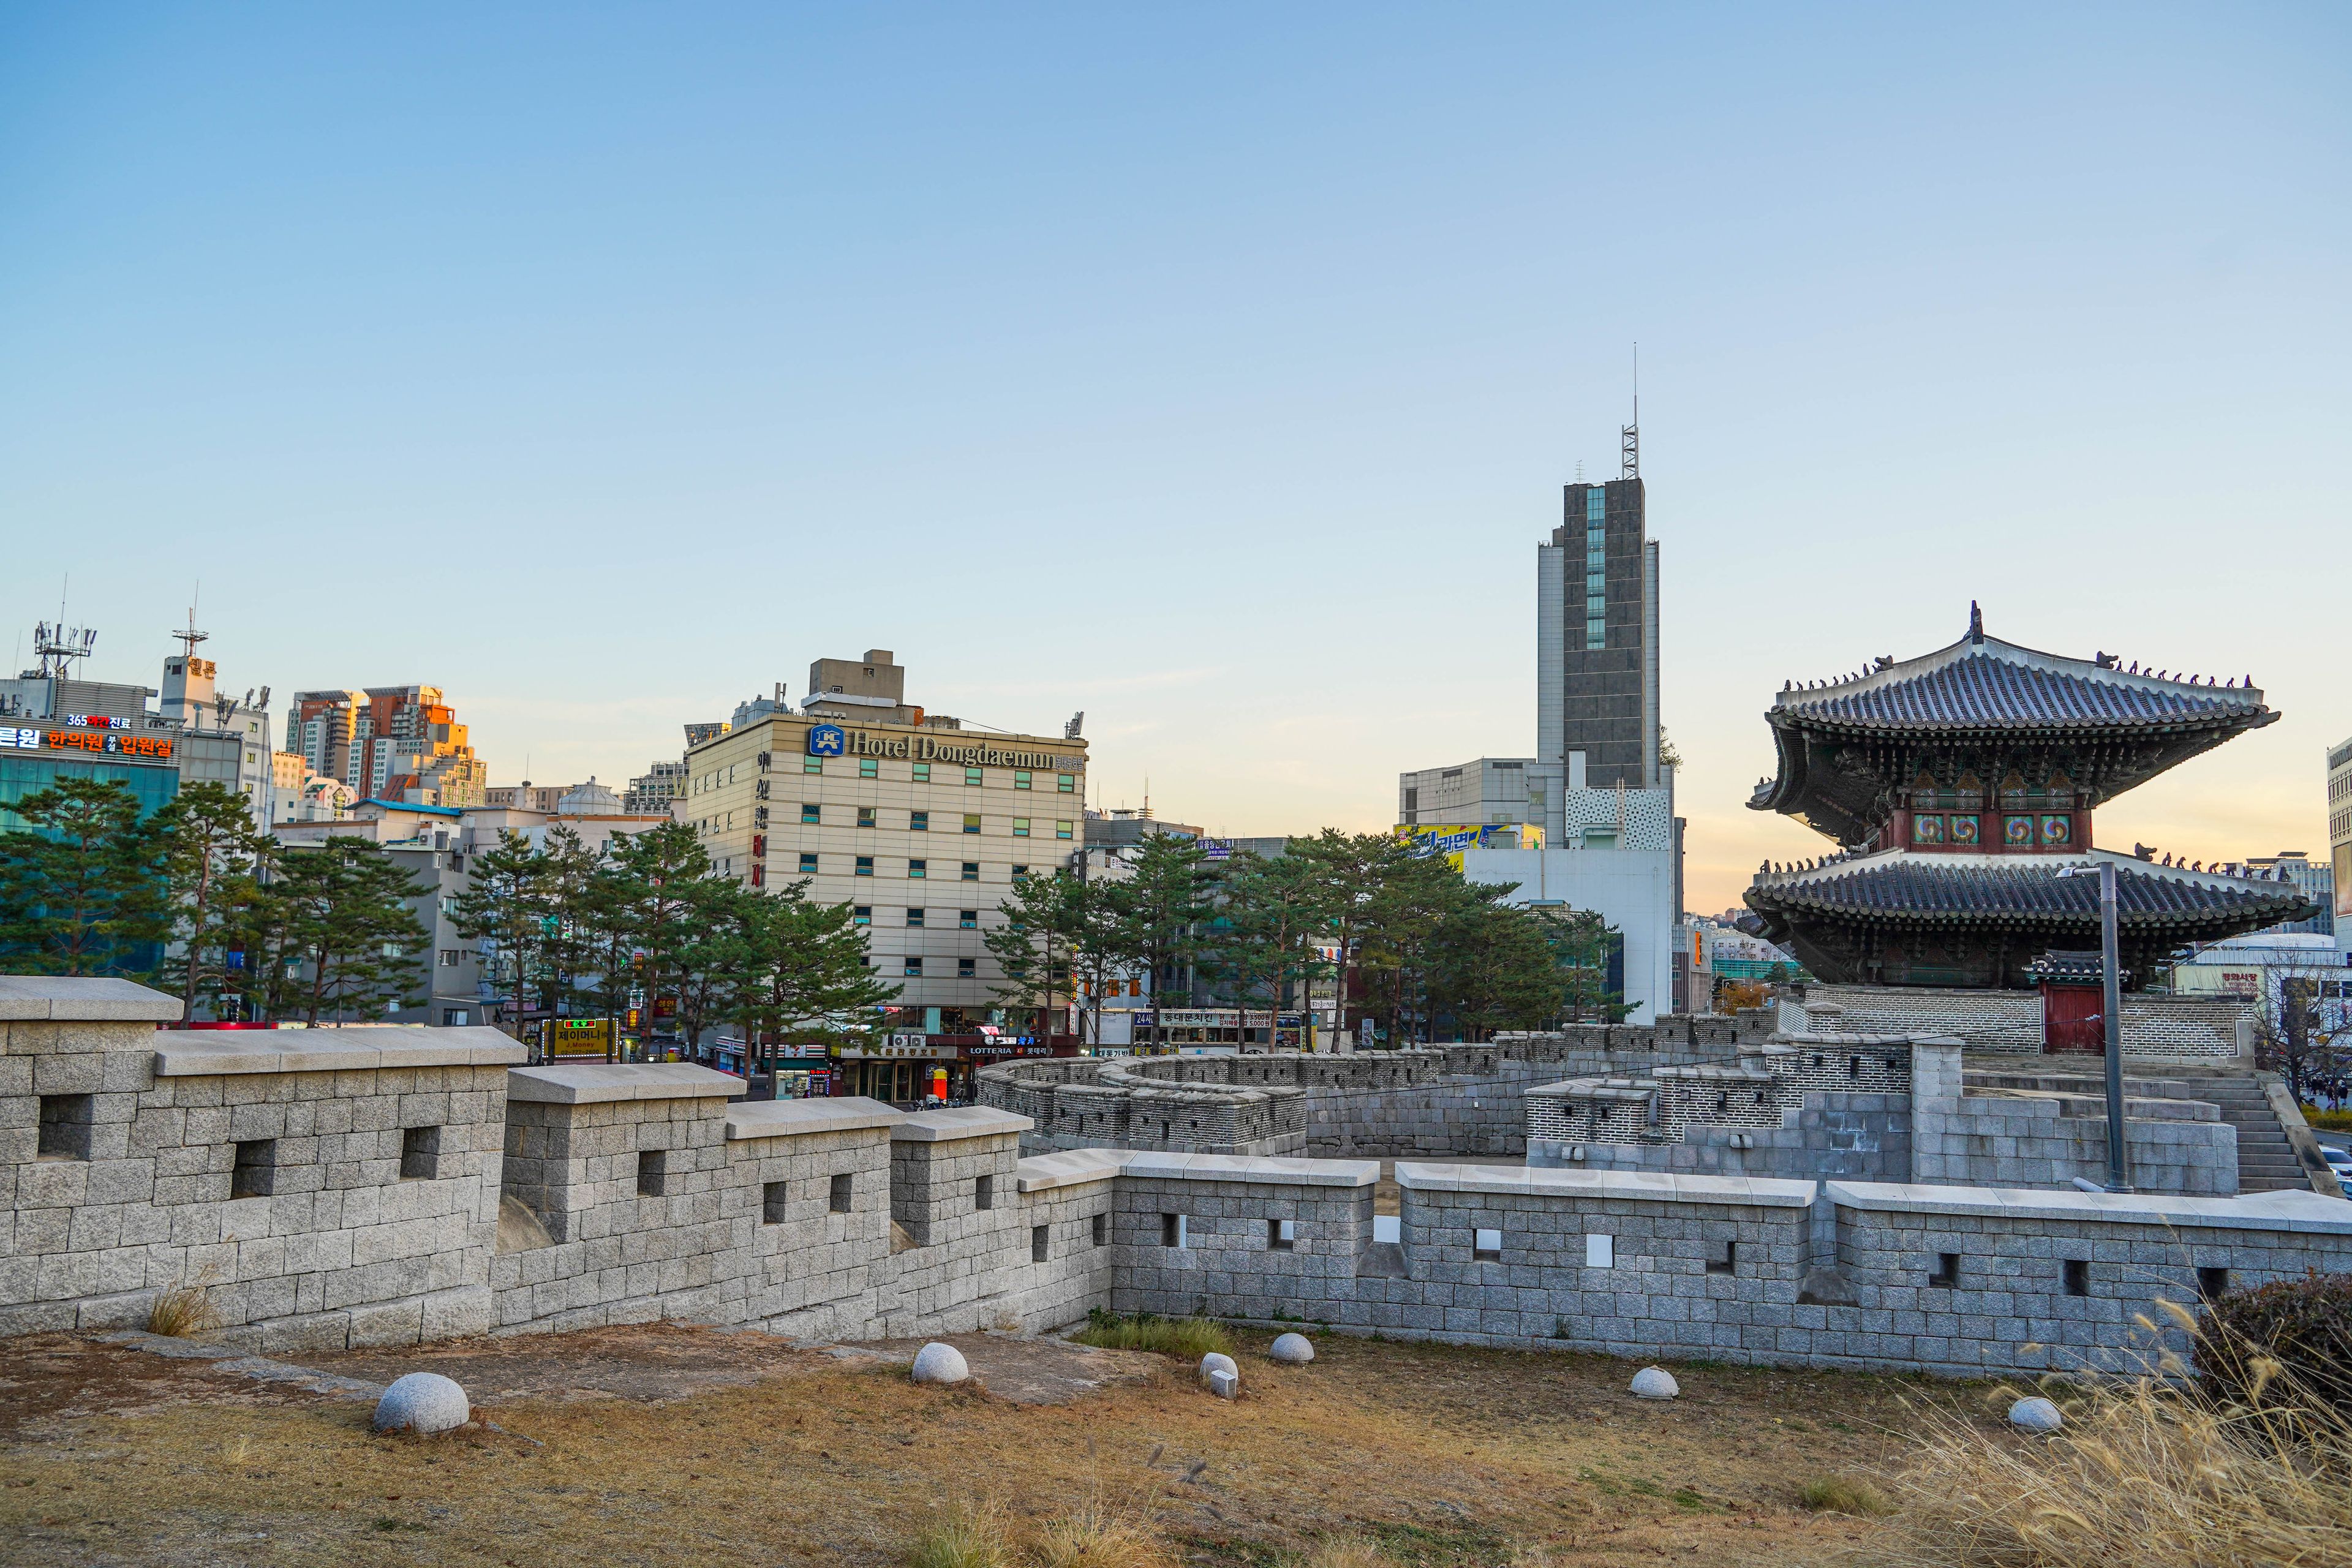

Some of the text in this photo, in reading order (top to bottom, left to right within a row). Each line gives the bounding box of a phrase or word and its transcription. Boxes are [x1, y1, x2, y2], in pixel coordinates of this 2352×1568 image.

[67, 714, 132, 729] 365야간진료
[48, 730, 103, 752] 한의원
[120, 736, 172, 758] 입원실
[851, 730, 1056, 769] Hotel Dongdaemun
[1056, 755, 1084, 771] 동대문호텔
[1164, 1013, 1213, 1022] 동대문치킨
[559, 1030, 600, 1041] 제이머니
